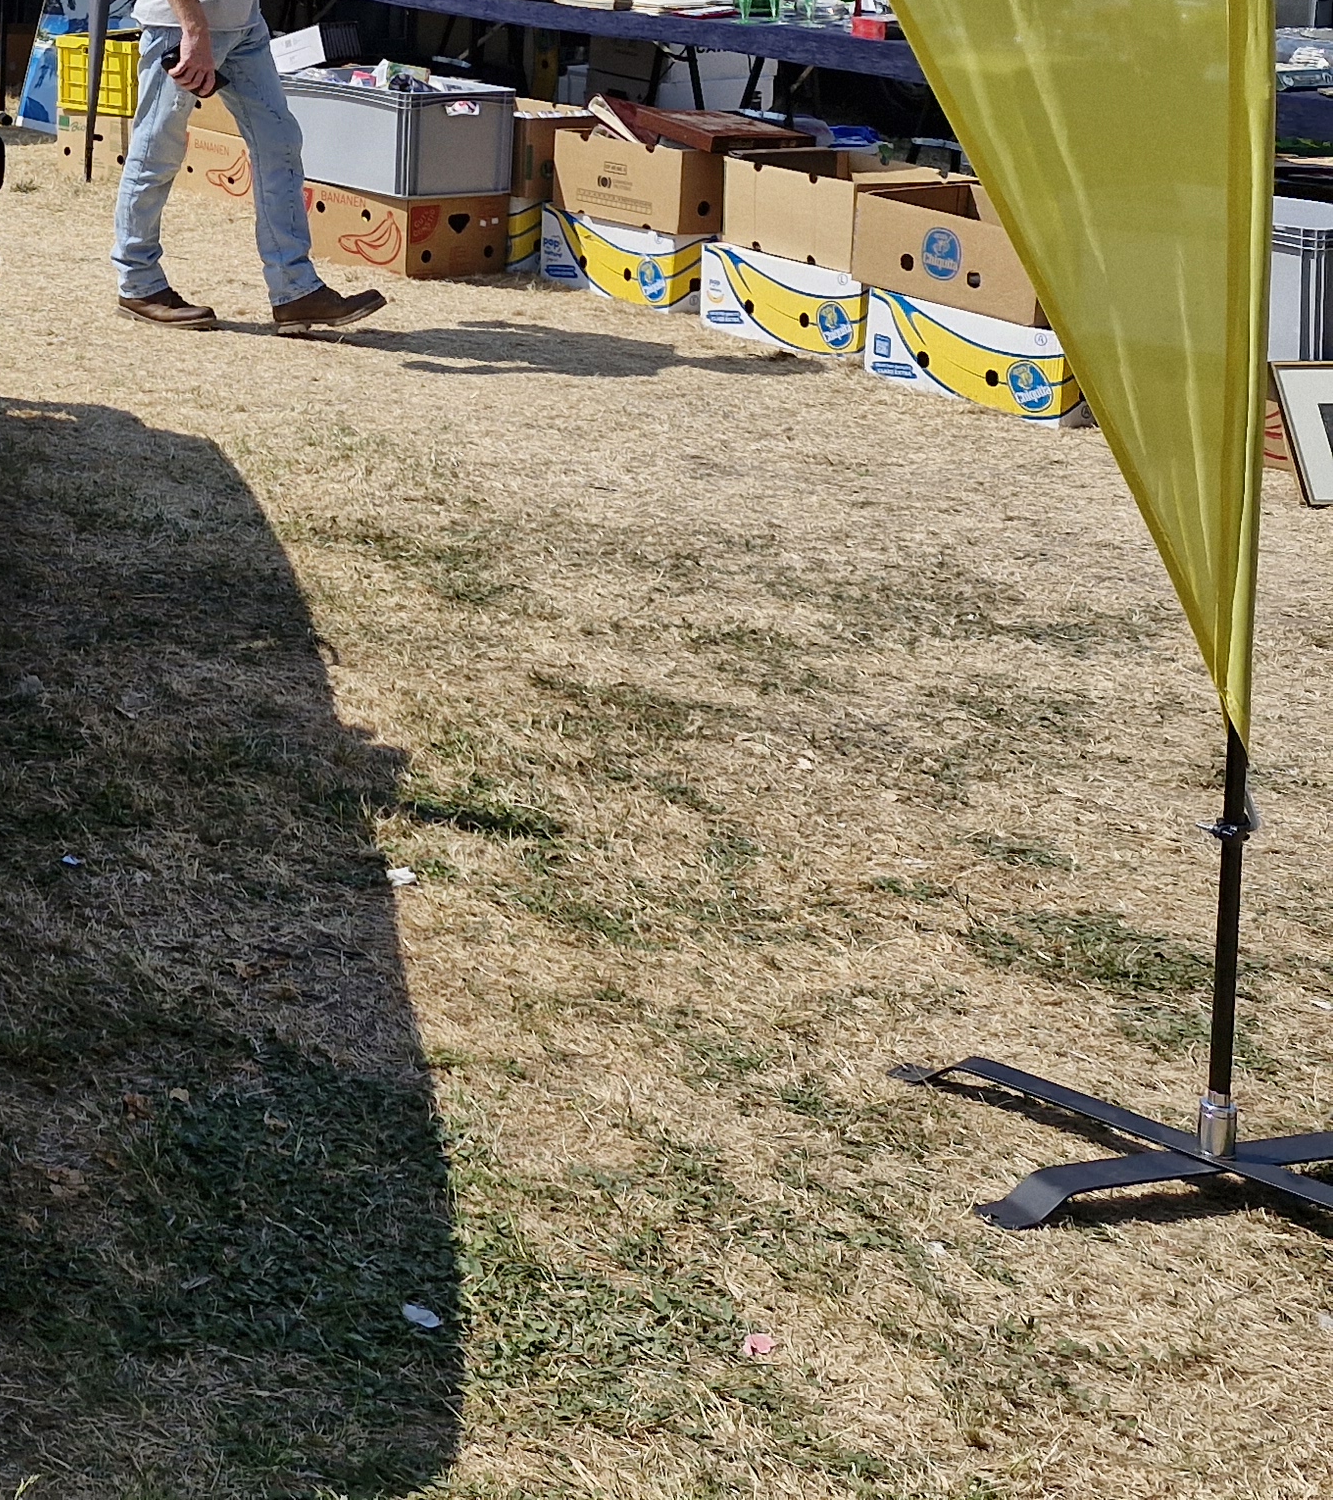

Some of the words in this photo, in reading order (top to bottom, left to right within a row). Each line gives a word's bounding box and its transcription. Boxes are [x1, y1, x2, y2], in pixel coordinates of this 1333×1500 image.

[194, 138, 230, 156] BANANEN
[321, 190, 367, 208] BANANEN
[923, 252, 958, 272] Chiquita
[1015, 385, 1052, 405] Chiquita
